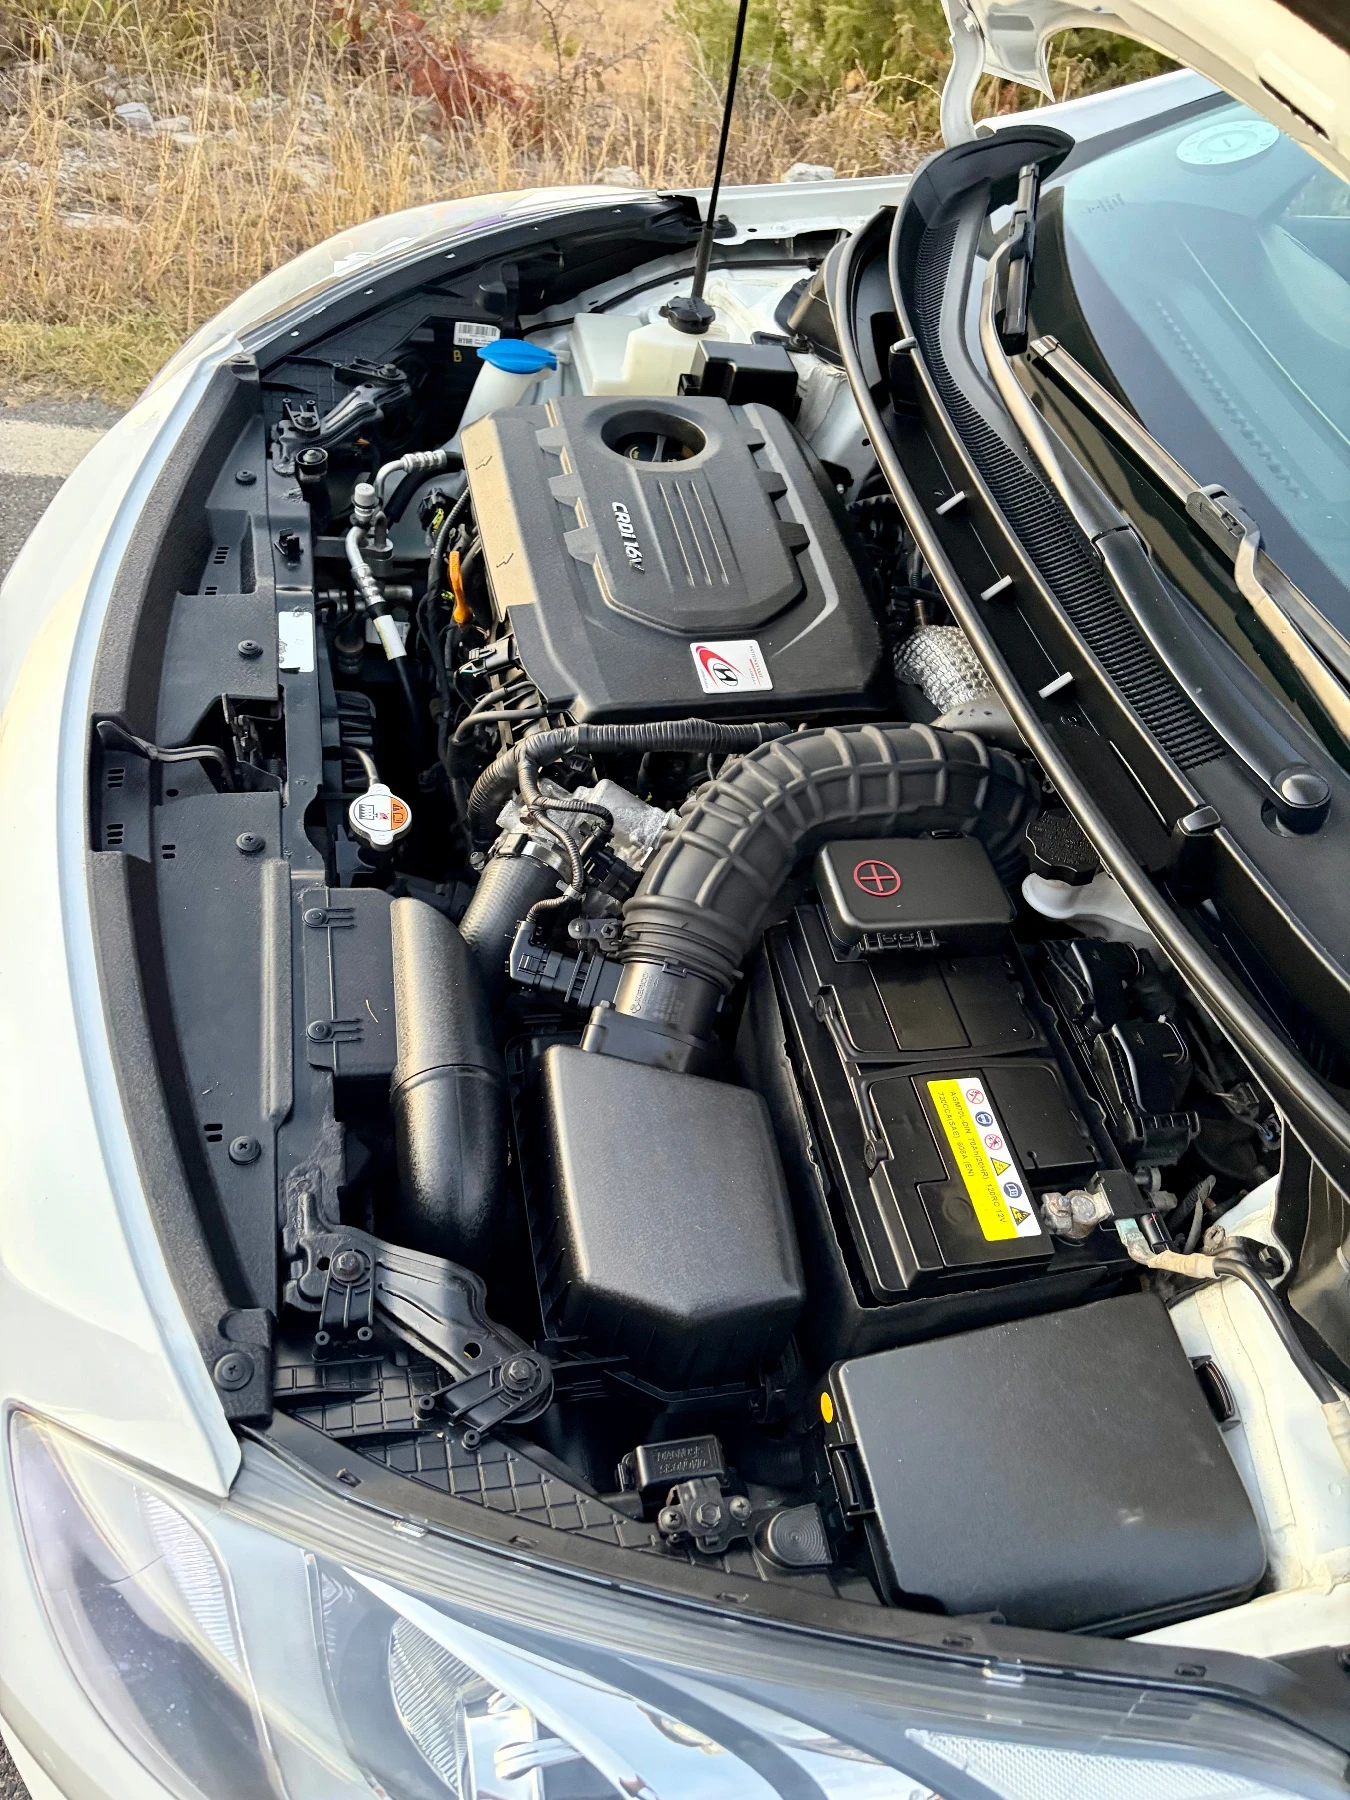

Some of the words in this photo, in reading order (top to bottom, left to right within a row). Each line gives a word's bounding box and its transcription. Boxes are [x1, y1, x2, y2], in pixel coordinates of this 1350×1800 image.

[453, 350, 462, 362] B
[611, 502, 637, 539] CRDi
[950, 1091, 972, 1134] AGM70L-DIN
[967, 1137, 989, 1180] 70Ah(20HR)
[985, 1183, 1001, 1208] 120RC
[996, 1208, 1007, 1223] 12V
[963, 1160, 975, 1177] (EN)
